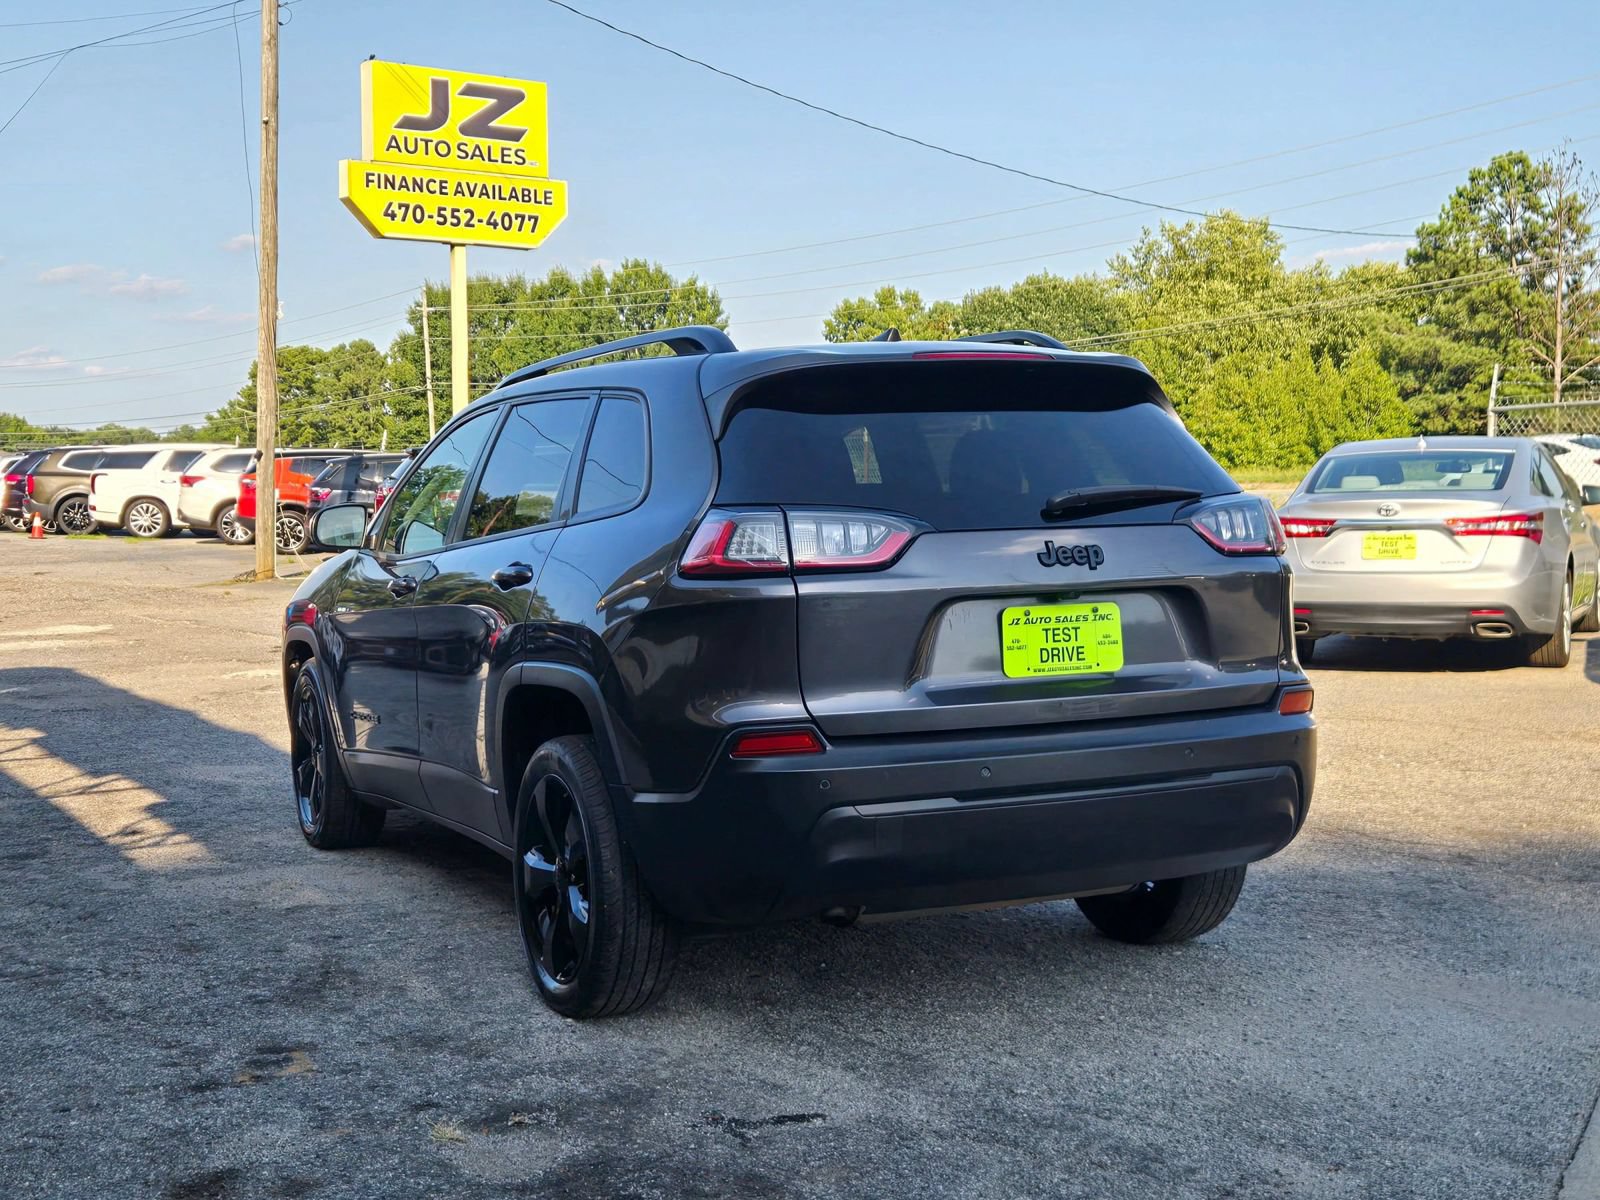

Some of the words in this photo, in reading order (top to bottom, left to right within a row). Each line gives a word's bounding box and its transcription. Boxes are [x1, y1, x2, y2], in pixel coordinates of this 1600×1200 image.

[393, 78, 529, 142] JZ
[385, 134, 452, 158] AUTO
[456, 142, 527, 166] SALES
[365, 172, 449, 196] FINANCE
[453, 181, 553, 206] AVAILABLE
[383, 202, 540, 234] 470-552-4077
[1037, 540, 1105, 570] Jeep
[1008, 617, 1021, 626] JZ
[1024, 616, 1052, 625] AUTO
[1054, 614, 1089, 623] SALES
[1092, 613, 1114, 622] INC.
[1042, 626, 1081, 644] TEST
[1040, 645, 1086, 664] DRIVE
